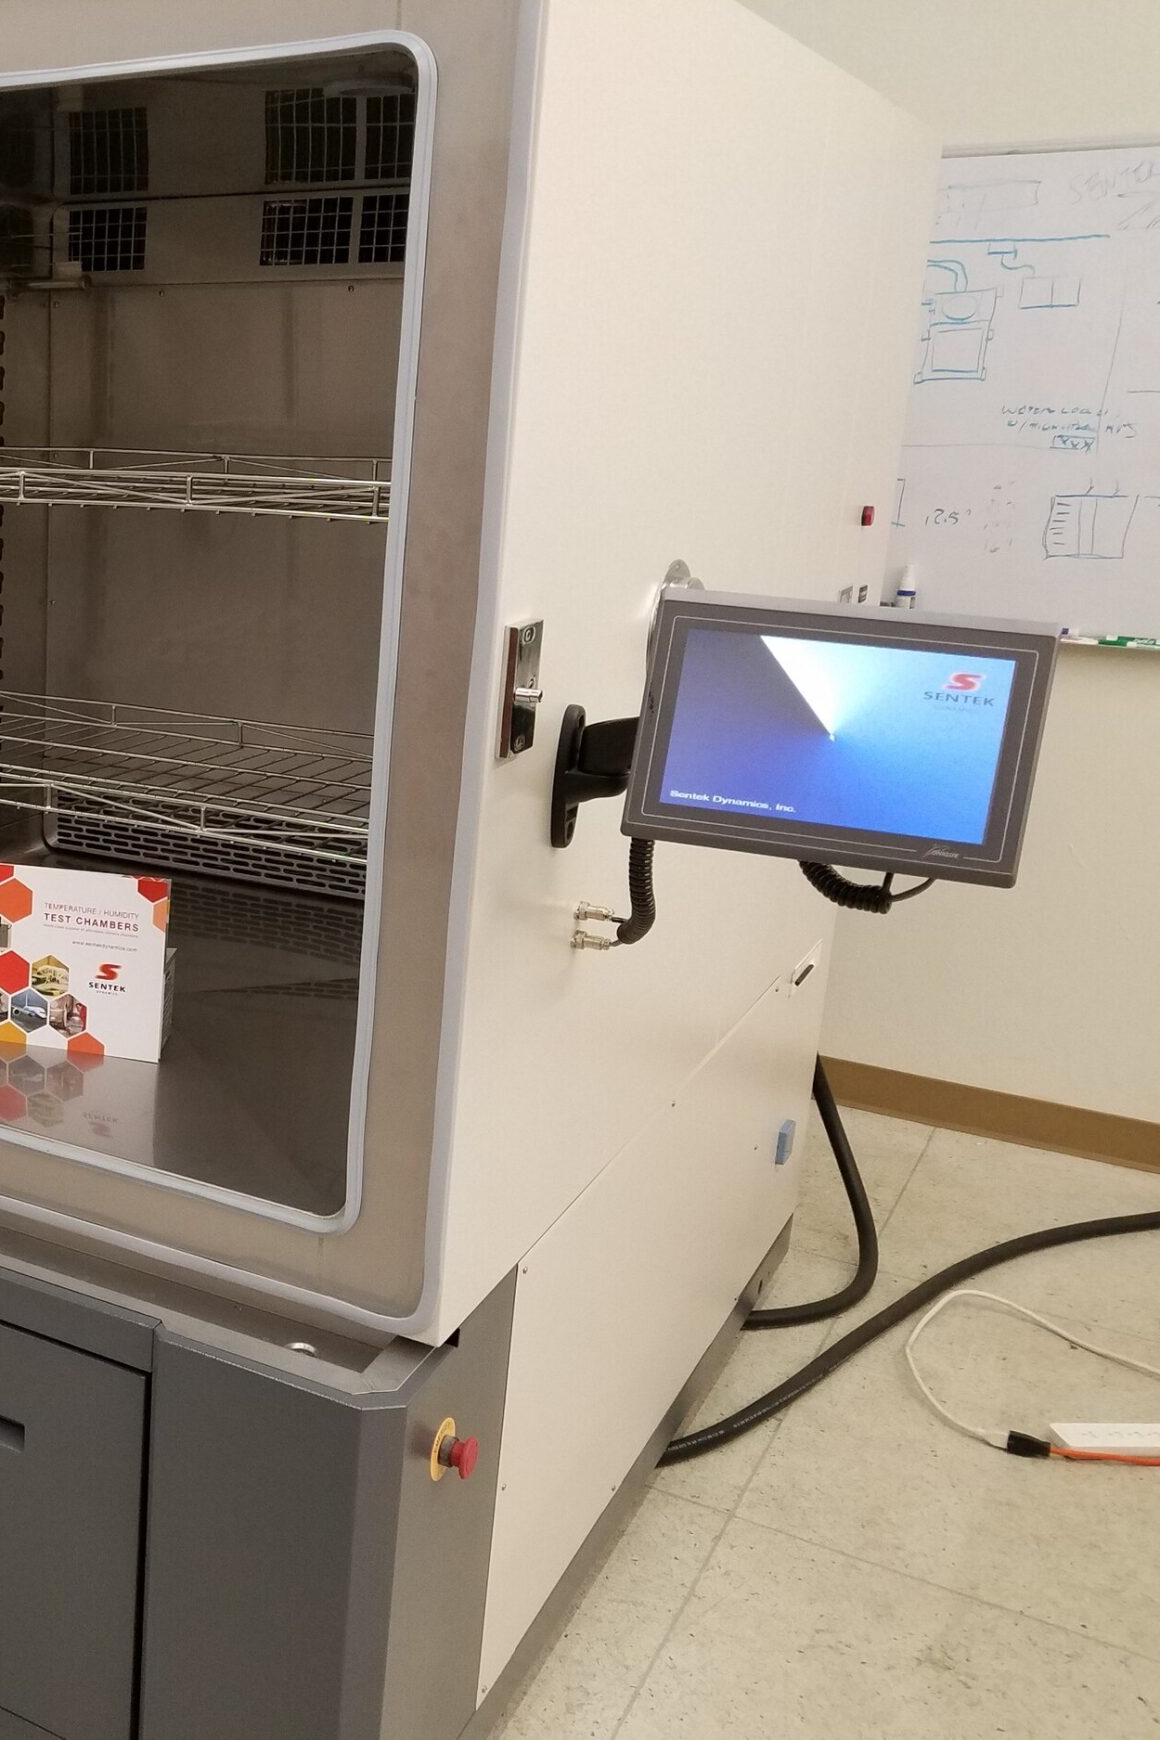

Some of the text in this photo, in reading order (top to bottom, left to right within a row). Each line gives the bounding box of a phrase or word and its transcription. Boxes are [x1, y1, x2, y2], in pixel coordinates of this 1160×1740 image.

[923, 691, 995, 707] SENTEK
[669, 789, 710, 802] Sentek
[775, 803, 797, 813] Inc.
[44, 902, 97, 915] TEMPERATURE
[103, 909, 140, 920] HUMIDITY
[44, 912, 71, 923] TEST
[75, 916, 140, 932] CHAMBERS
[88, 981, 126, 993] SENTEK
